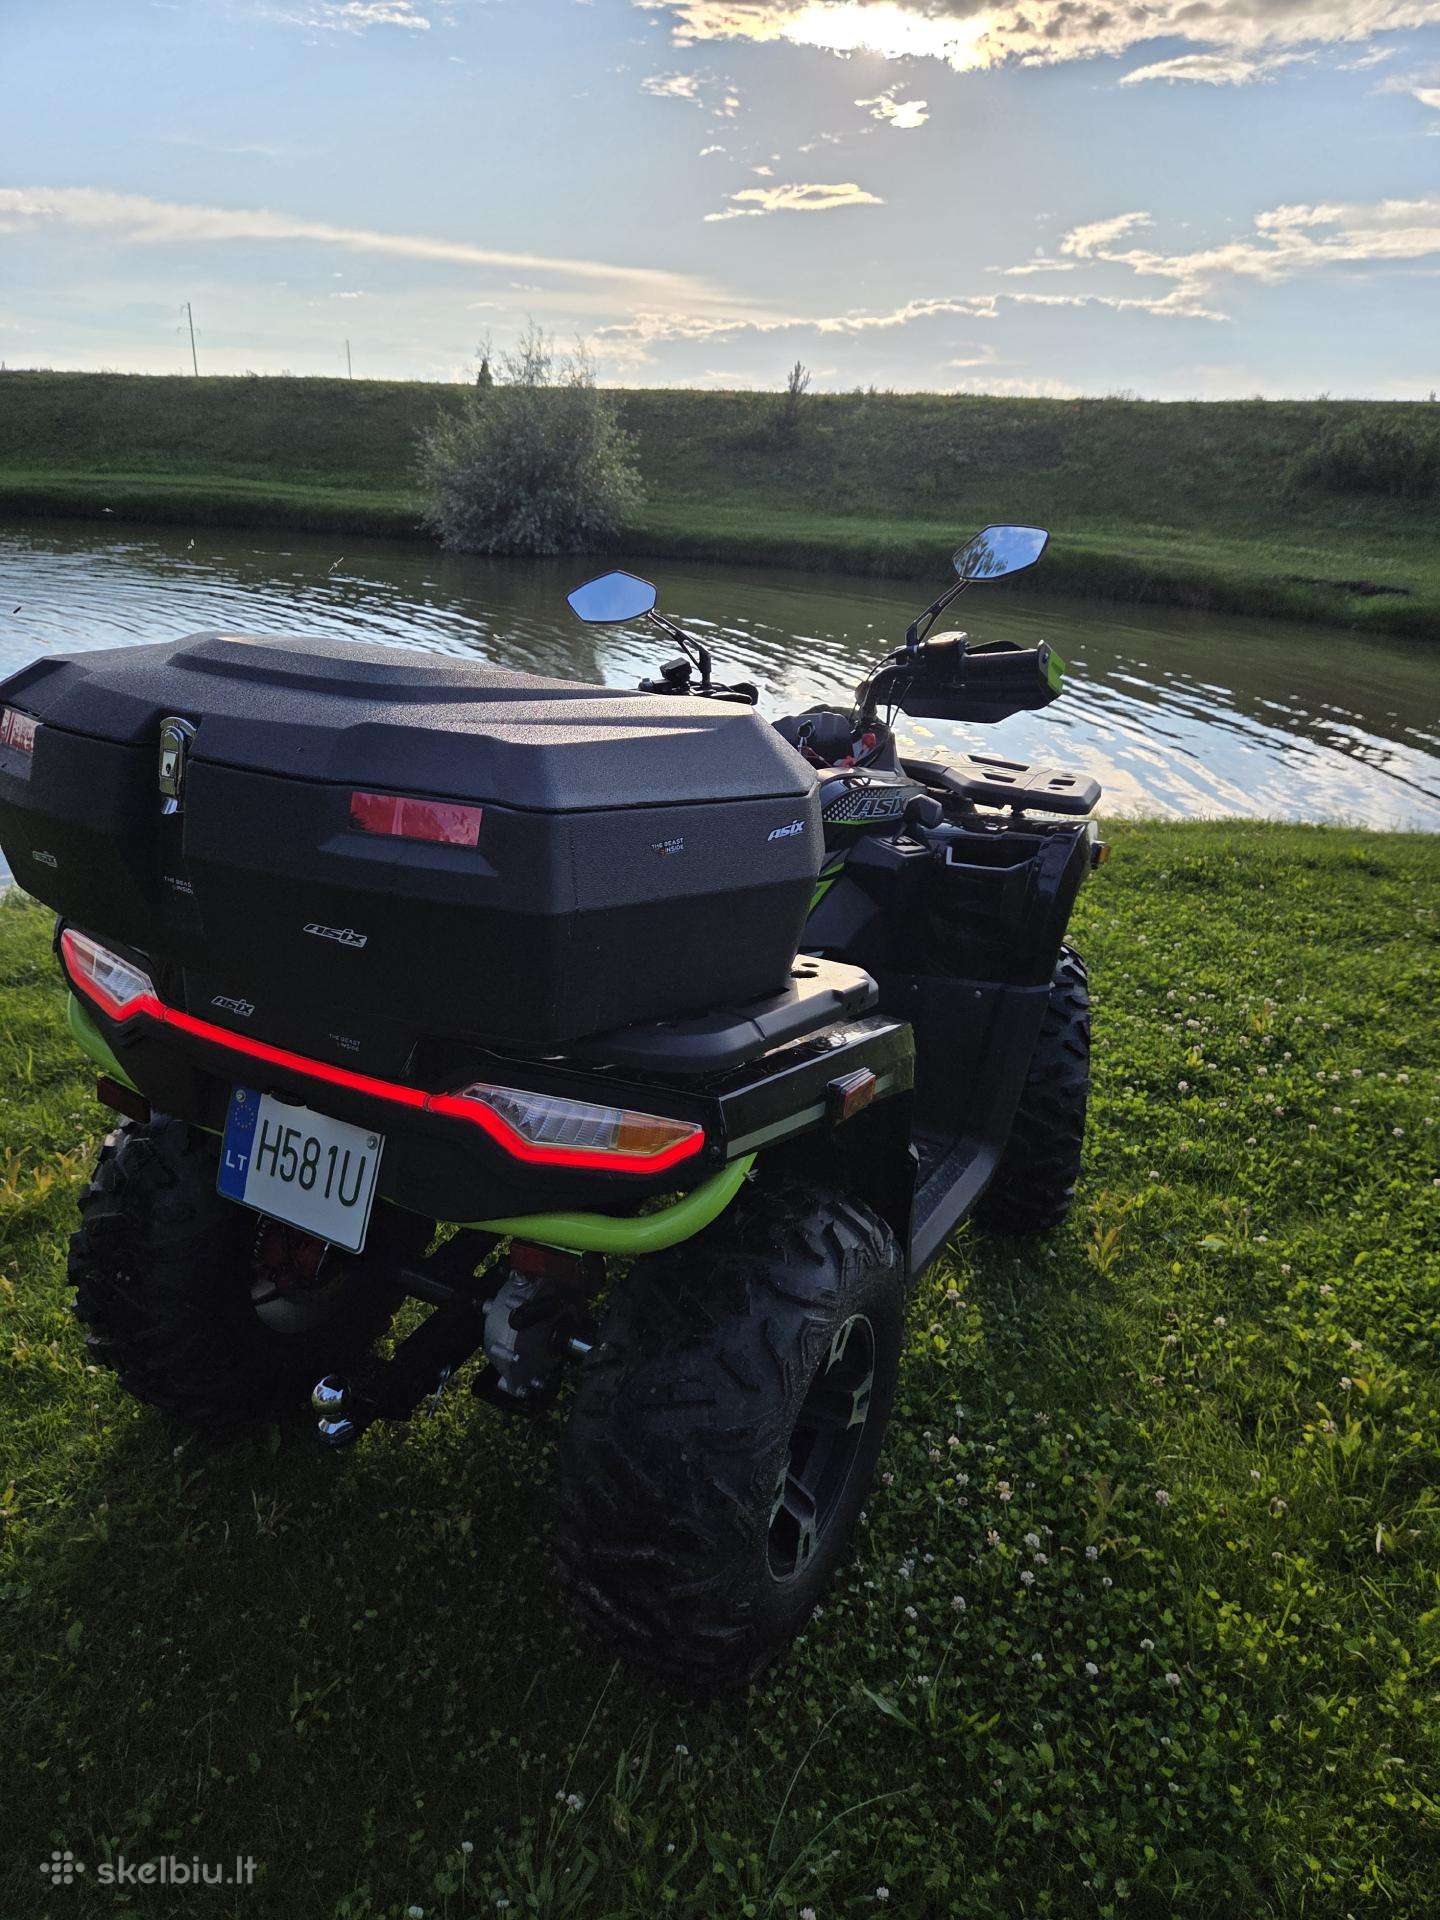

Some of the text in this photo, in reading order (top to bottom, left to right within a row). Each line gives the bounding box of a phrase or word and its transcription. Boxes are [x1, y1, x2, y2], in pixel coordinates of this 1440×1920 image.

[650, 837, 684, 850] THE BEAST
[225, 1149, 248, 1171] LT
[256, 1119, 366, 1207] H581U
